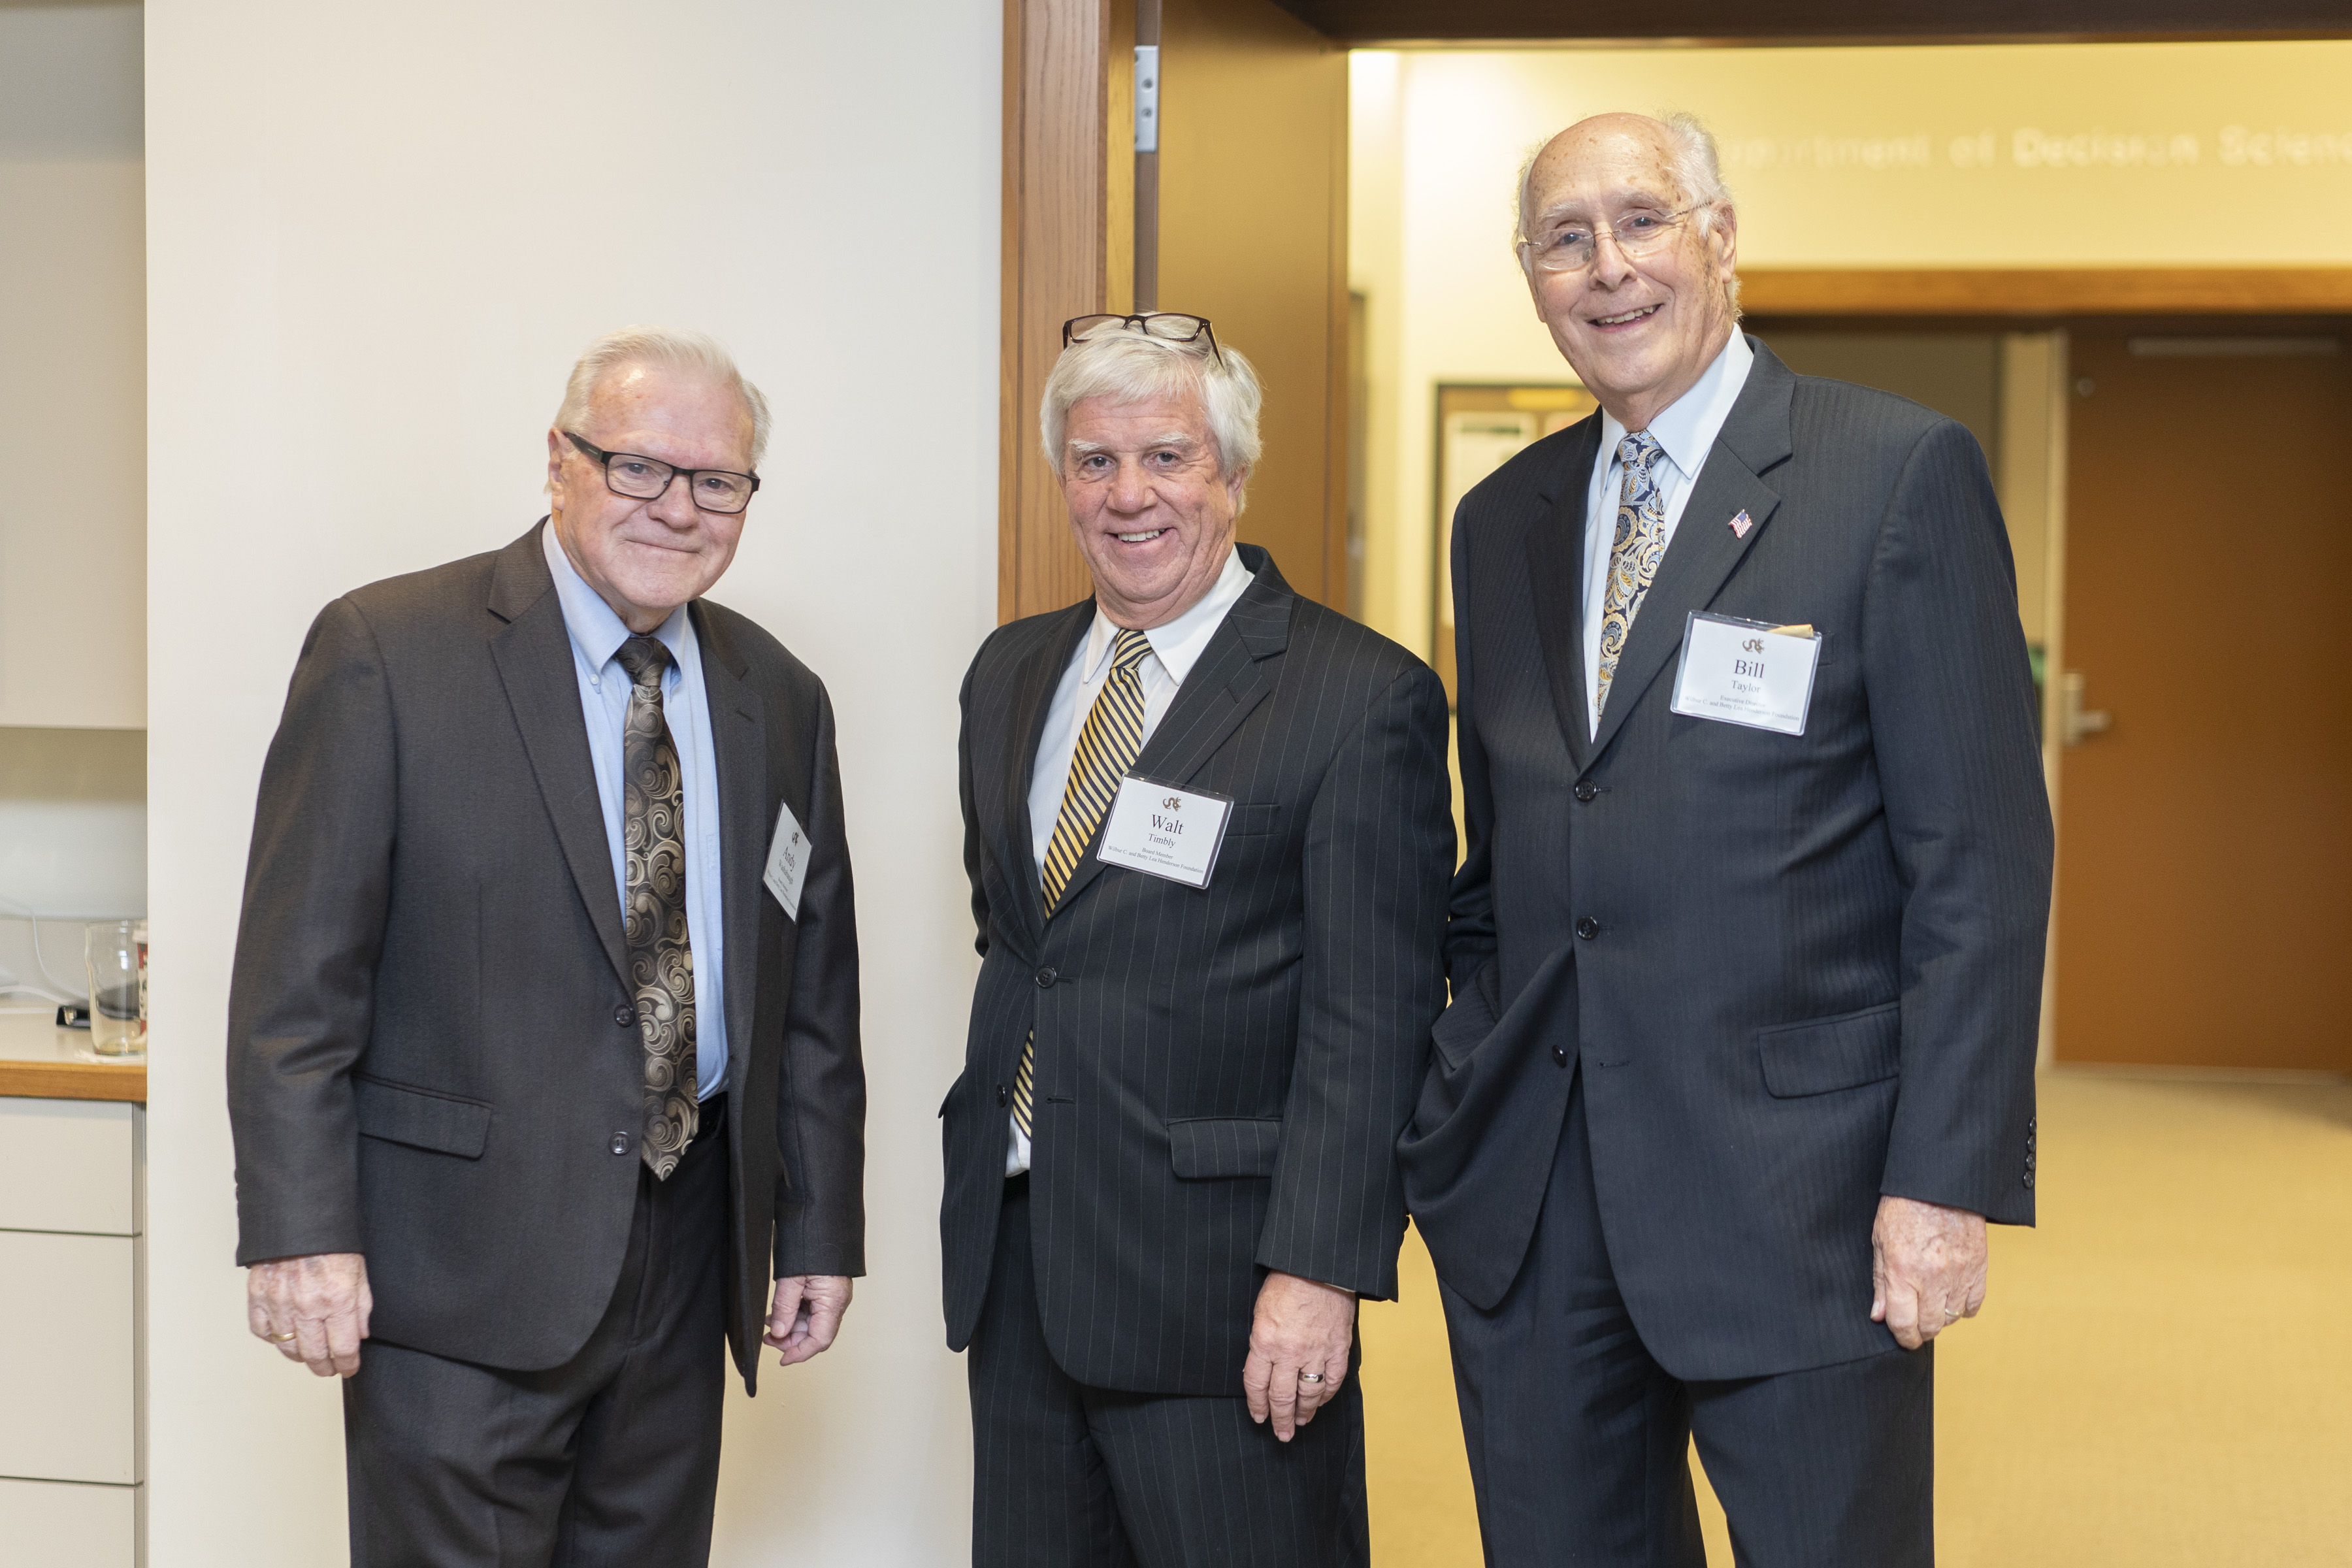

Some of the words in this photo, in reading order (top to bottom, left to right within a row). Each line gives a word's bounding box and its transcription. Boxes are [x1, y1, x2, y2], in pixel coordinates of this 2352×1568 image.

[1949, 128, 1996, 167] of
[1734, 659, 1764, 678] Bill
[1731, 680, 1761, 693] Taylor
[1720, 695, 1744, 704] Executive
[1772, 711, 1799, 721] Foundation
[1152, 814, 1184, 834] Walt
[1149, 834, 1176, 848] Timbly
[783, 847, 796, 872] Andy
[1158, 858, 1180, 868] Henderson
[1181, 864, 1203, 874] Foundation
